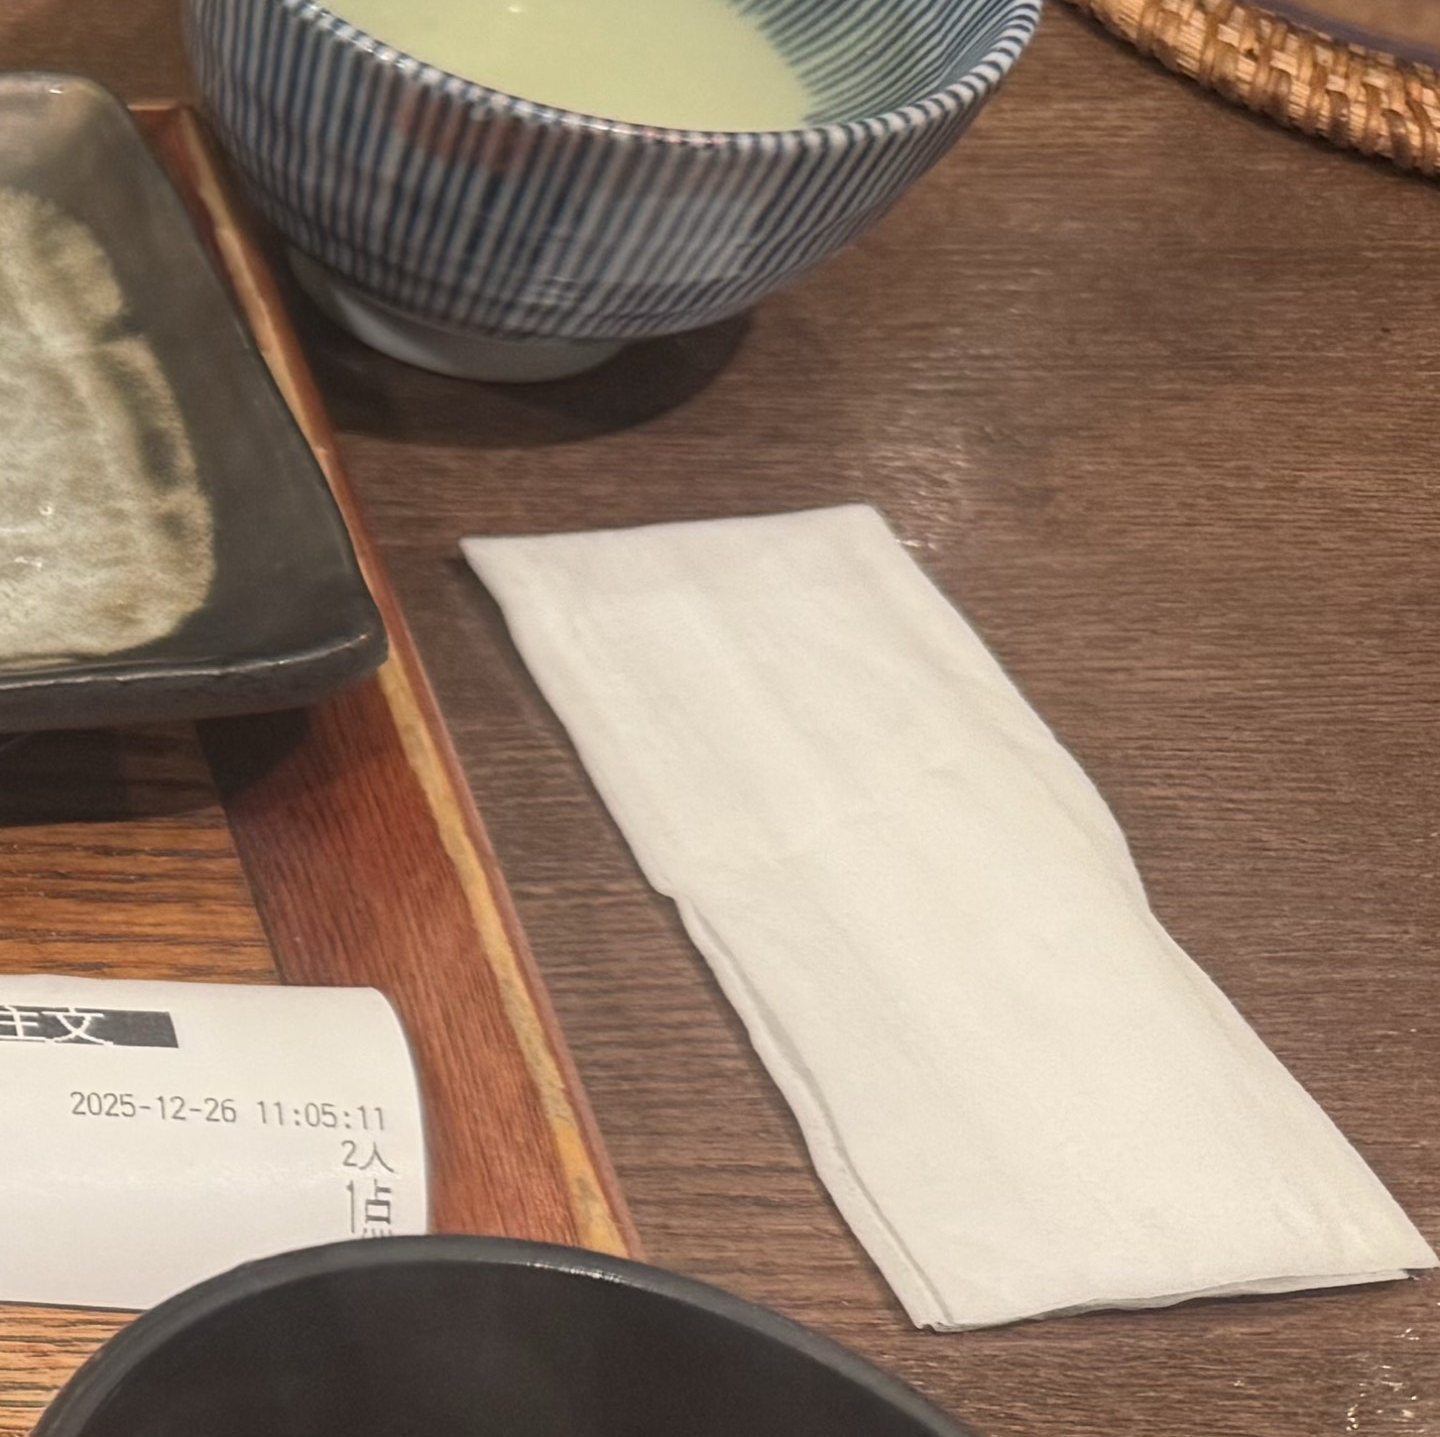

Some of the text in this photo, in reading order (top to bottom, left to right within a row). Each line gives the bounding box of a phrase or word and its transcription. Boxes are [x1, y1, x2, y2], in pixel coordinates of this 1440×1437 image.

[69, 1091, 237, 1123] 2025-12-26
[257, 1100, 386, 1131] 11:05:11
[340, 1139, 395, 1174] 2人
